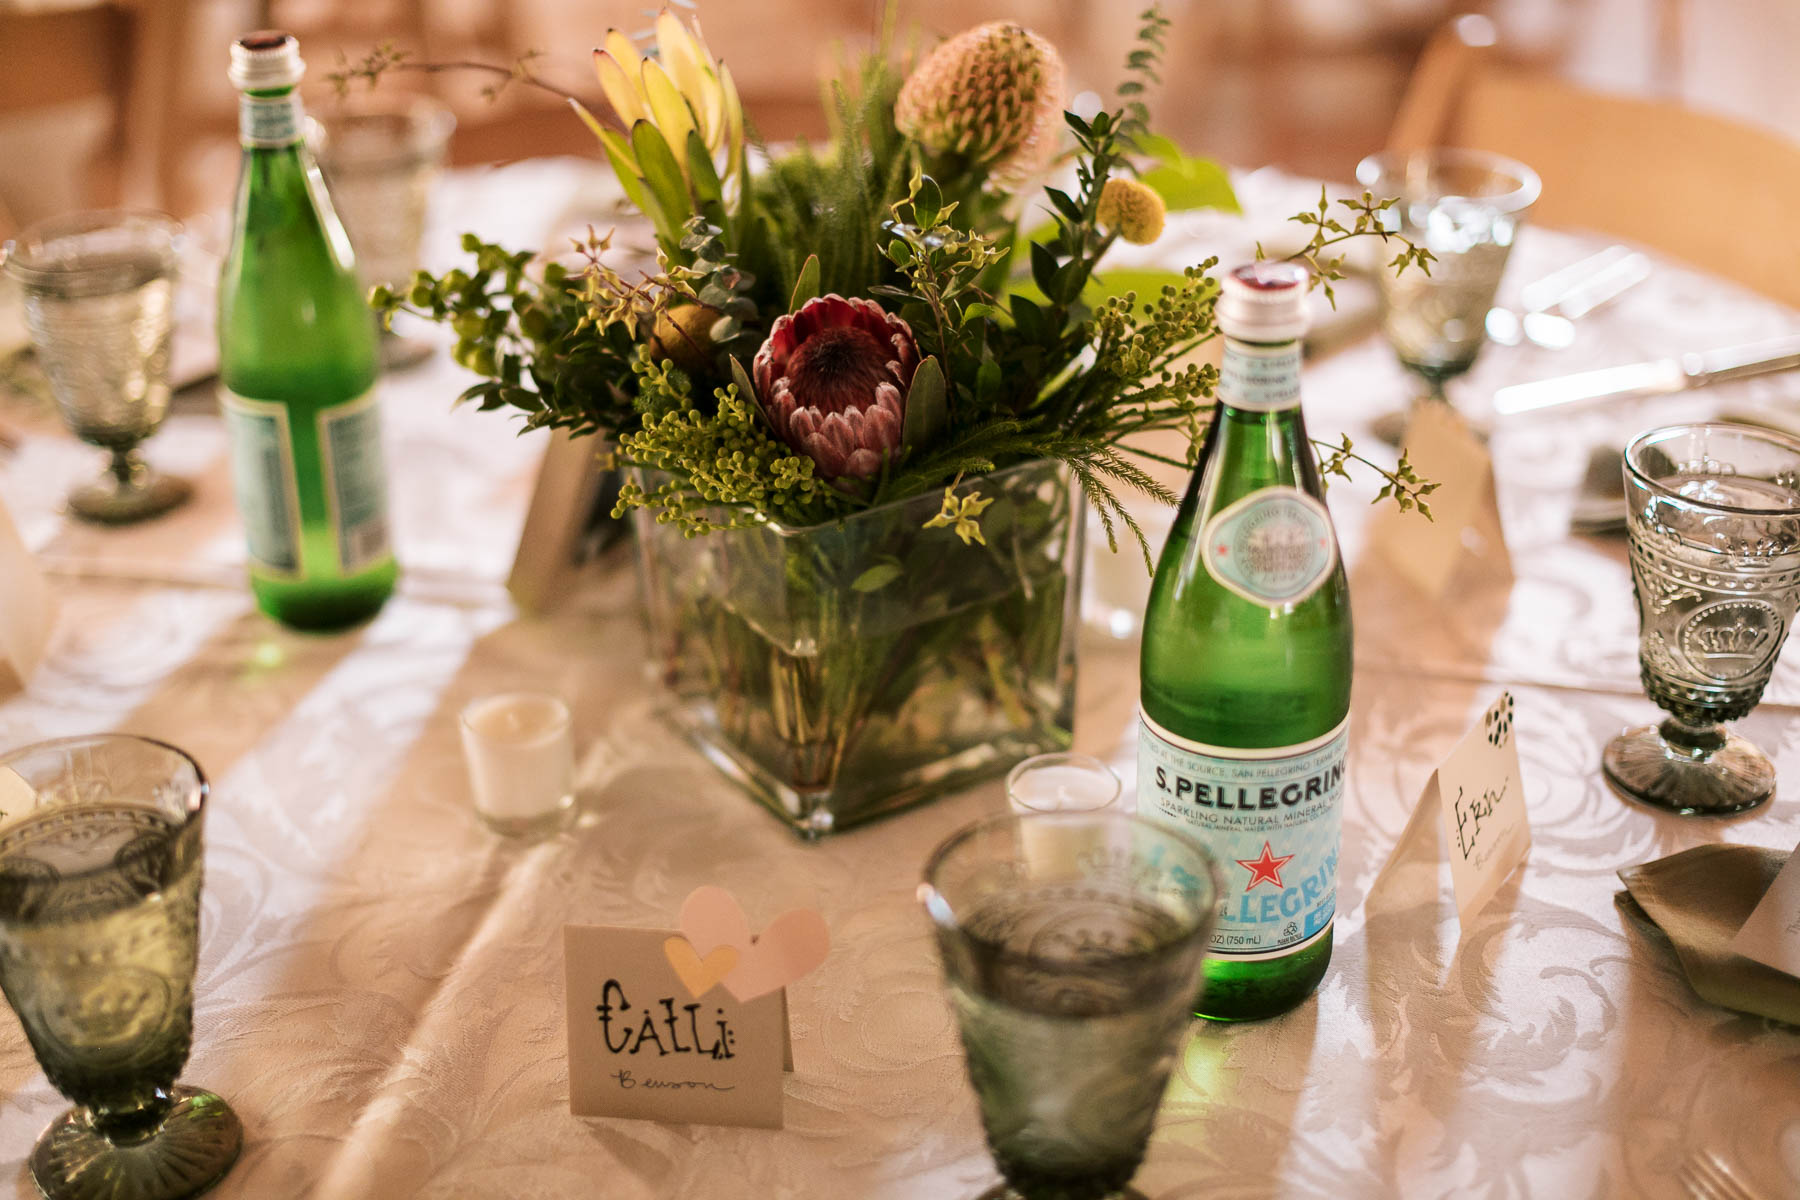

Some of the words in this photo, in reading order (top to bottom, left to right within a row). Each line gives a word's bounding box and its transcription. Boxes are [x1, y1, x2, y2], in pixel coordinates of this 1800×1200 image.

[1231, 767, 1254, 778] SAN
[1256, 760, 1311, 778] PELLEGRINO
[1160, 796, 1219, 823] SPARKLING
[1223, 814, 1279, 826] NATURAL
[1283, 799, 1328, 821] MINERAL
[1226, 935, 1244, 946] (750
[1246, 935, 1262, 946] mL)
